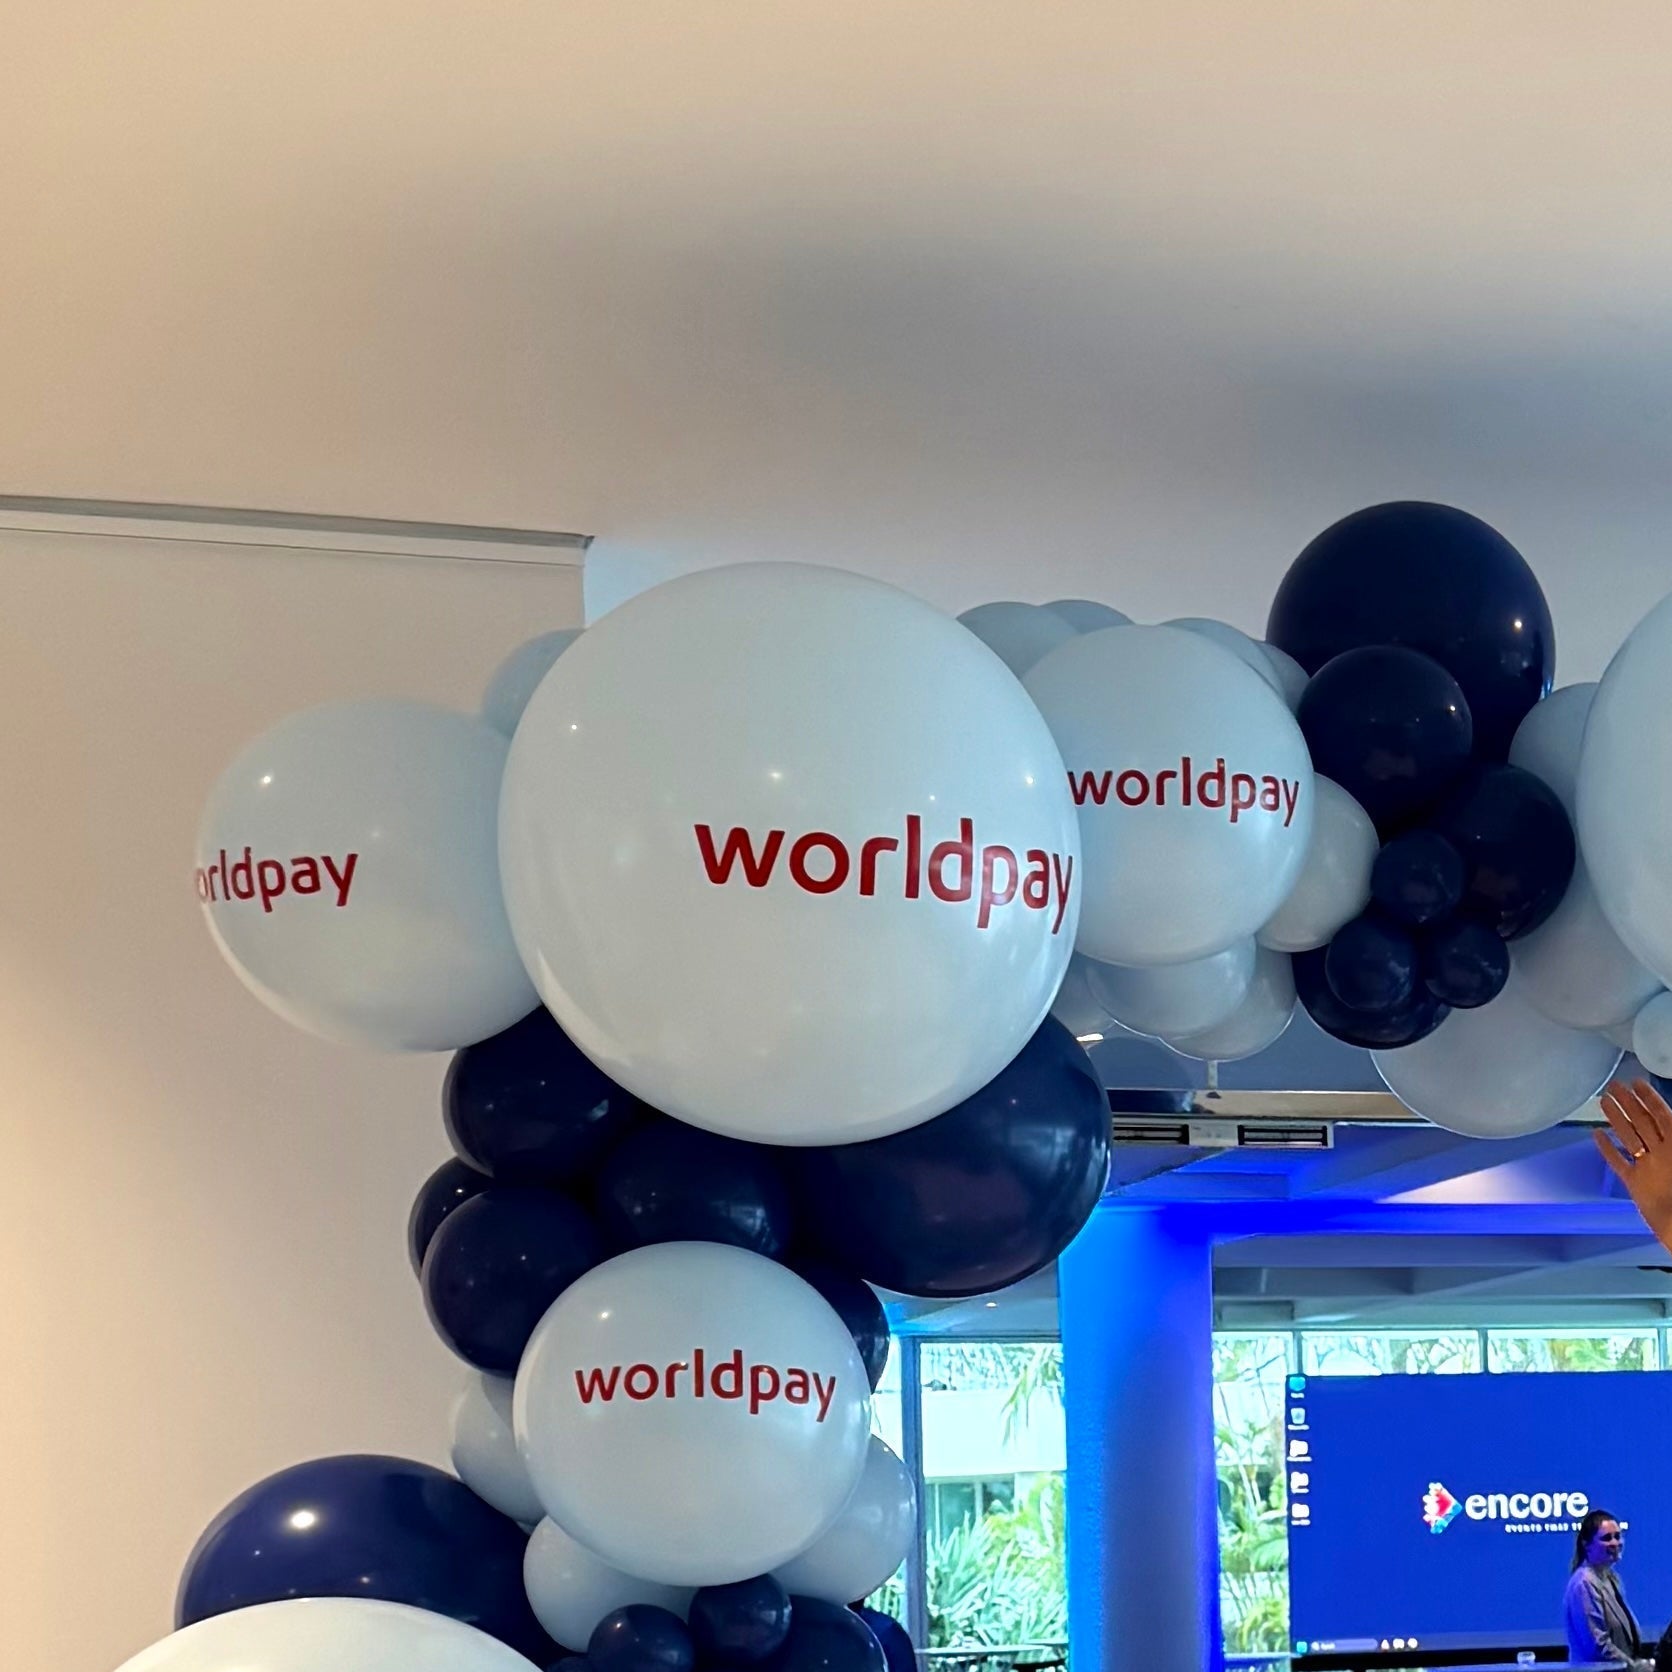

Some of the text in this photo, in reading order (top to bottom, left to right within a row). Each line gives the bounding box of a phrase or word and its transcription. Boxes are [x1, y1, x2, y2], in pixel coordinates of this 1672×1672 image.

[1067, 756, 1299, 827] worldpay
[196, 846, 358, 912] orldpay
[694, 814, 1073, 935] worldpay
[574, 1348, 836, 1422] worldpay
[1465, 1491, 1589, 1520] encore
